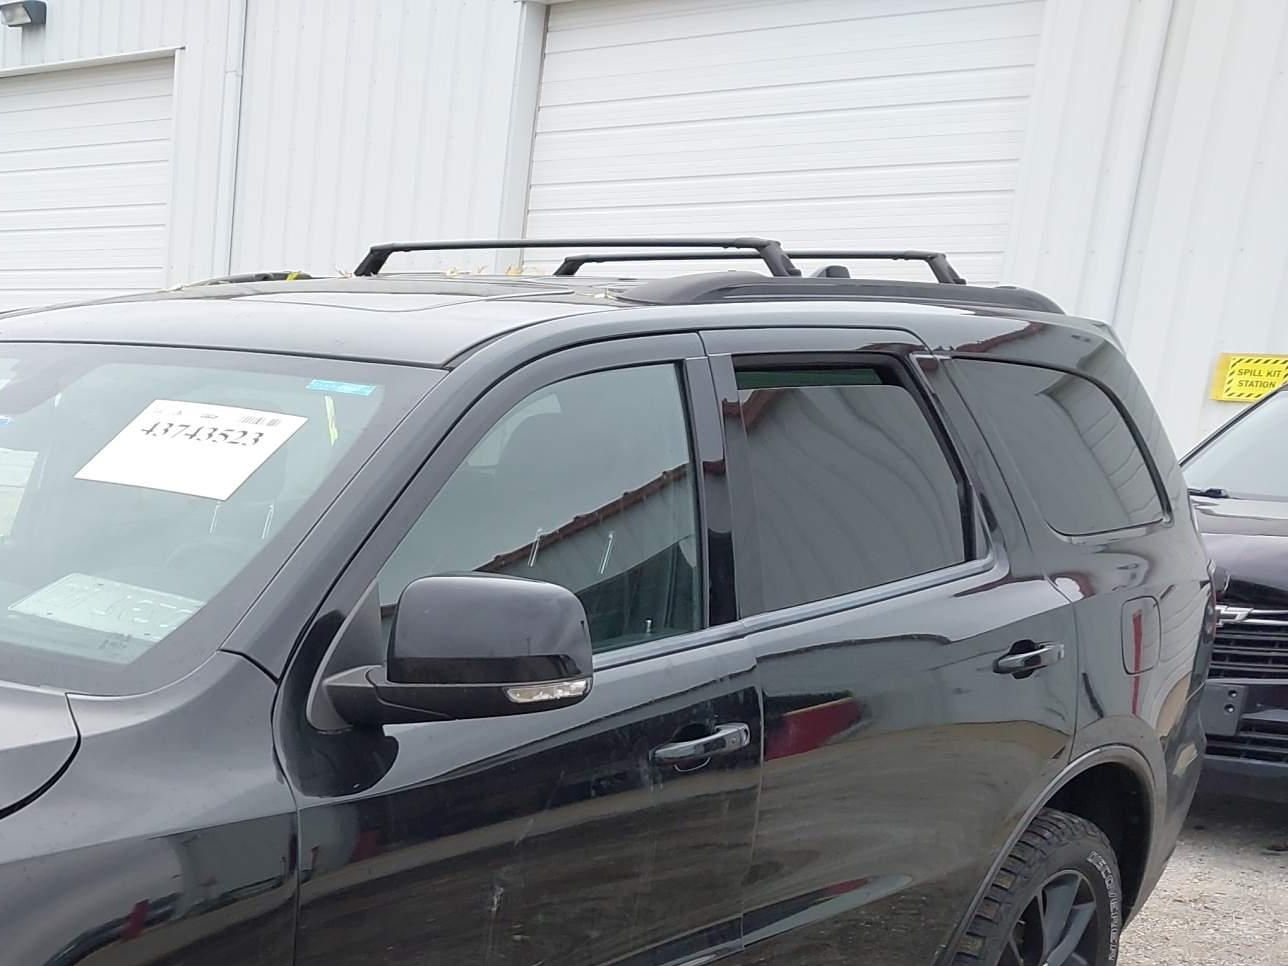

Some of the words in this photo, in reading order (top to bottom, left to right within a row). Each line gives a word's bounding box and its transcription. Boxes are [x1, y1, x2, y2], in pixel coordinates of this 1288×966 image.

[1237, 368, 1263, 377] SPILL
[1266, 370, 1282, 378] KIT
[1237, 379, 1277, 388] STATION
[140, 422, 264, 446] 43743523
